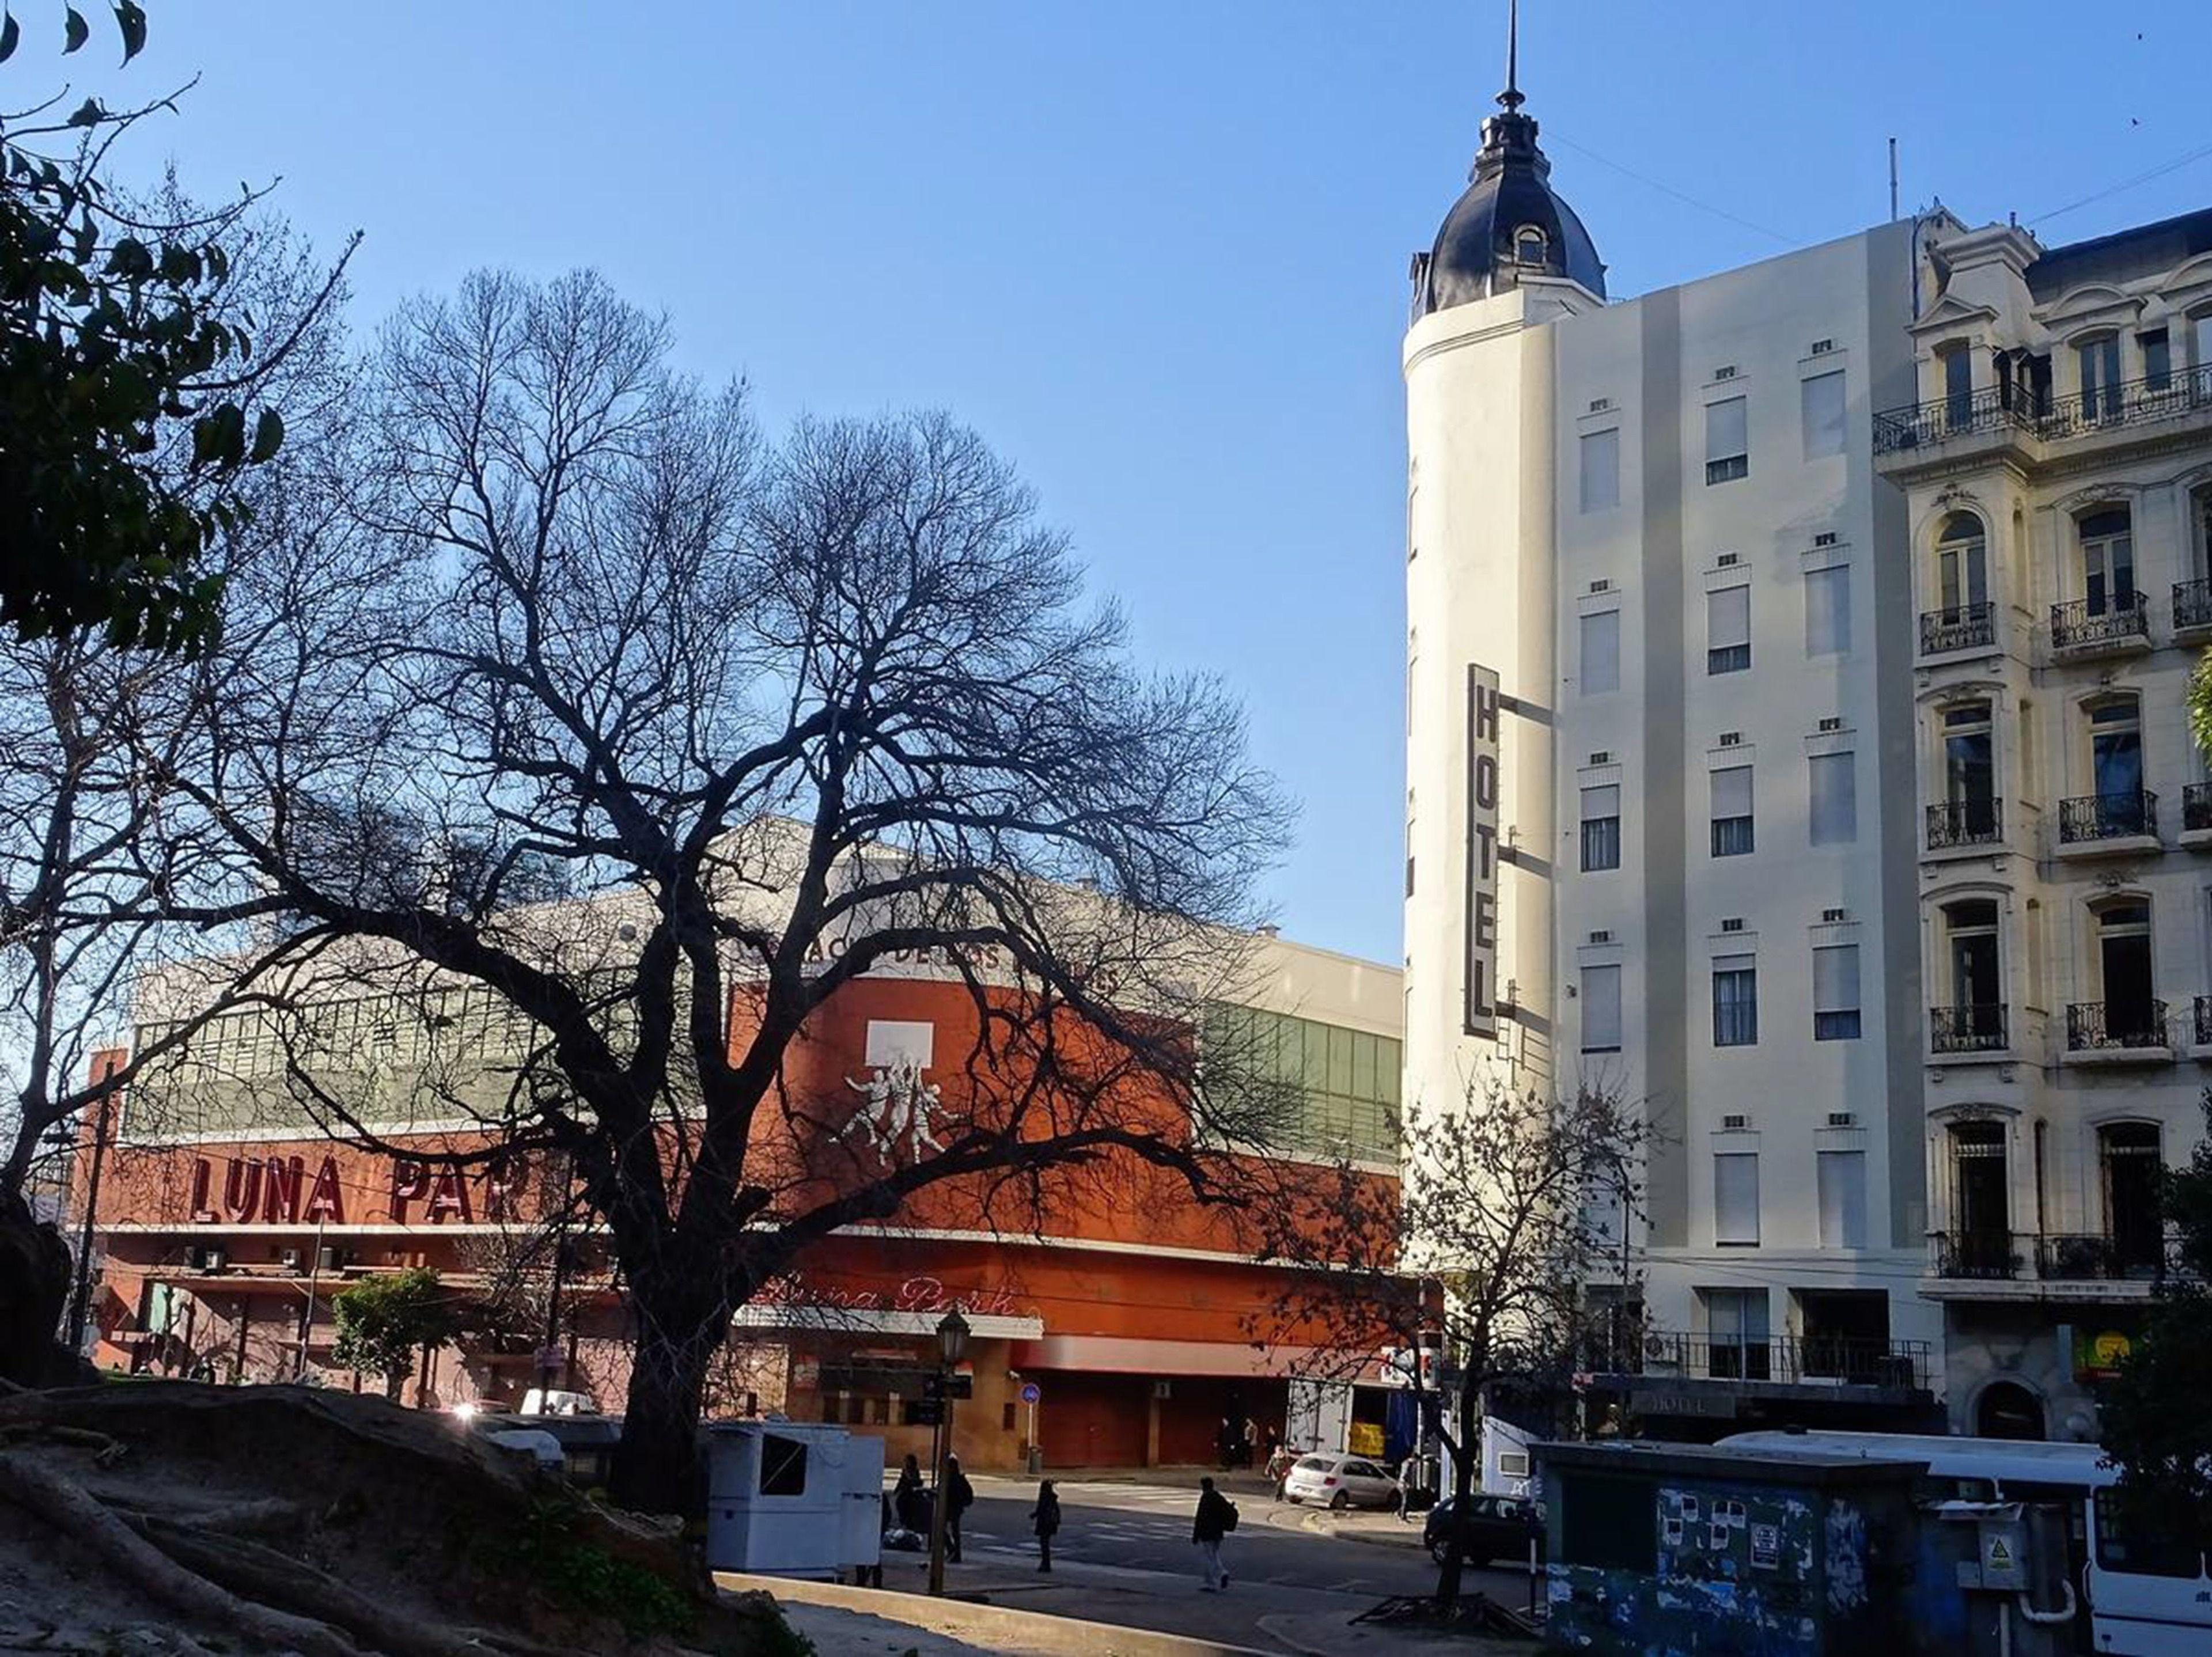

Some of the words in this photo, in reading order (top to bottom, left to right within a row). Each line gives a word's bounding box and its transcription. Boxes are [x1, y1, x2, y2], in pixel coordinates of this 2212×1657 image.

[1475, 684, 1497, 1017] HOTEL
[190, 1155, 345, 1224] LUNA
[389, 1157, 544, 1225] PAR
